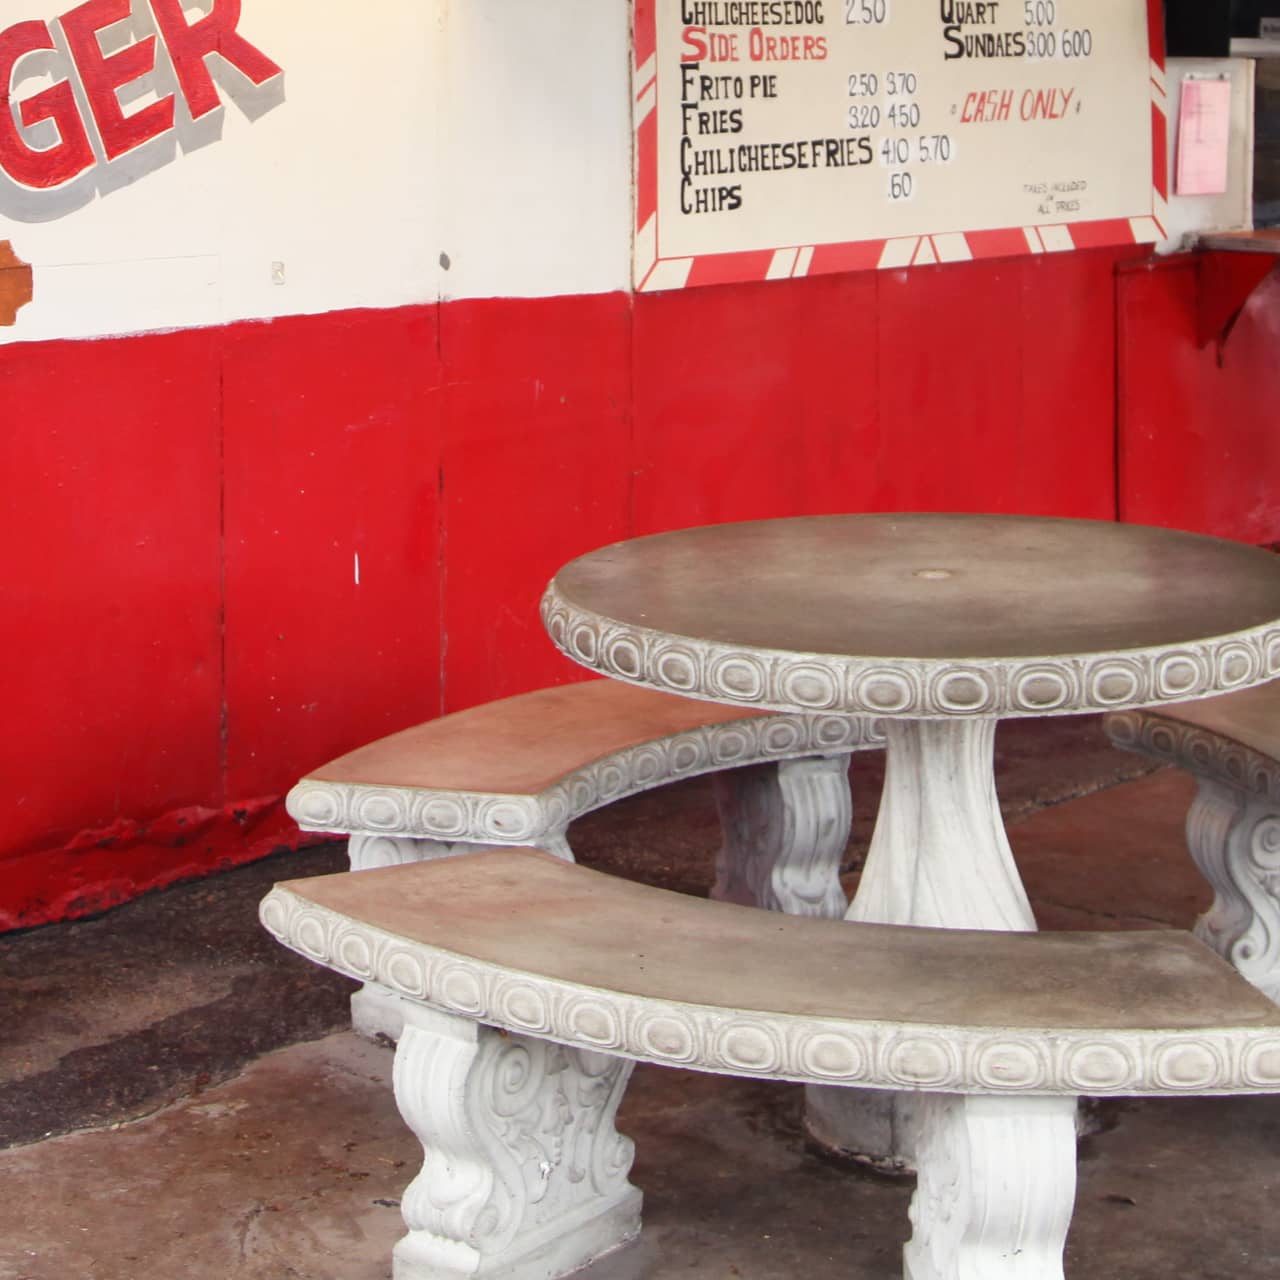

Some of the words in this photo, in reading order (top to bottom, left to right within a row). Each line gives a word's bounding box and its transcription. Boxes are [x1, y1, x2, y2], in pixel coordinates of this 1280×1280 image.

[1024, 0, 1056, 26] 5.00
[680, 25, 740, 63] SIDE
[748, 27, 828, 62] ORDERS
[943, 24, 1026, 61] SUNDAES
[680, 62, 744, 101] FRITO
[749, 75, 778, 99] PIE
[848, 73, 878, 97] 2.50
[886, 71, 917, 96] 3.70
[680, 103, 744, 136] FRIES
[848, 105, 880, 129] 3.20
[960, 89, 1014, 123] CASH
[1020, 87, 1075, 122] ONLY
[919, 134, 951, 162] 5.70
[680, 175, 743, 215] CHIPS
